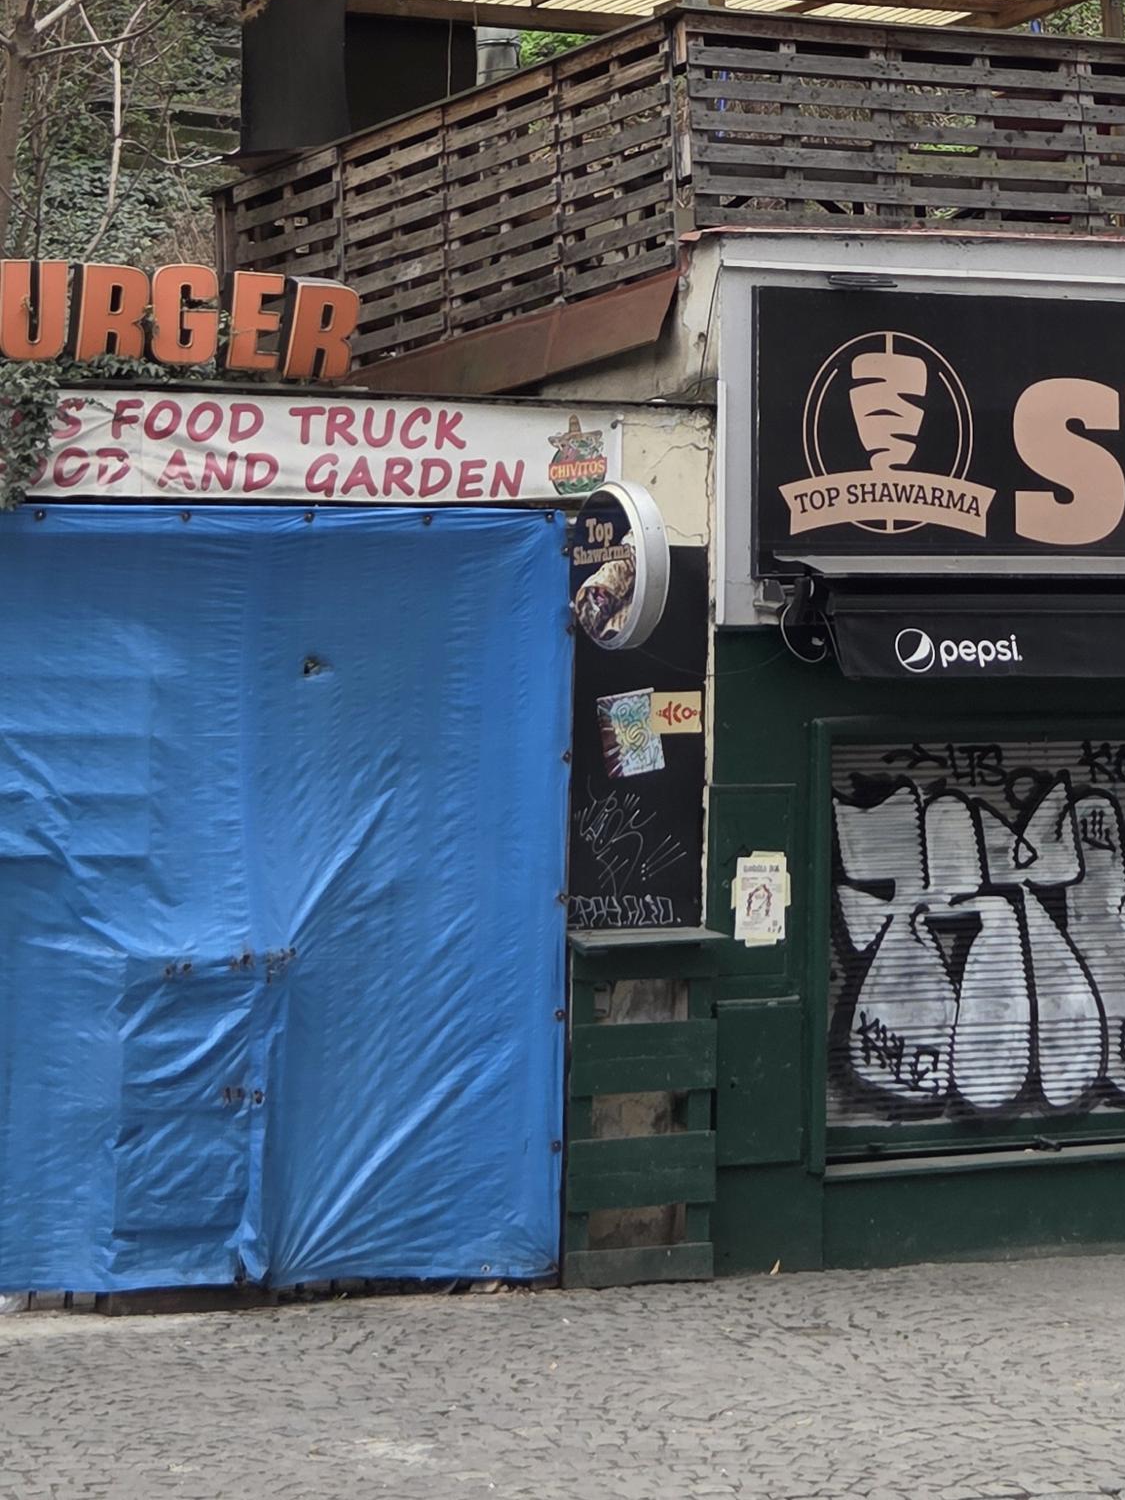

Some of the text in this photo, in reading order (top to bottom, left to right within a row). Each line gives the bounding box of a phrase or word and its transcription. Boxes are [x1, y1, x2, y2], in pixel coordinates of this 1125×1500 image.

[1, 259, 361, 380] URGER
[111, 398, 264, 443] FOOD
[289, 406, 467, 449] TRUCK
[157, 449, 279, 493] AND
[305, 453, 525, 499] GARDEN
[550, 459, 606, 480] CHIVITOS
[794, 482, 982, 517] TOP SHAWARMA
[585, 517, 614, 547] Top
[573, 543, 632, 566] Shawarma
[939, 634, 1022, 668] pepsi
